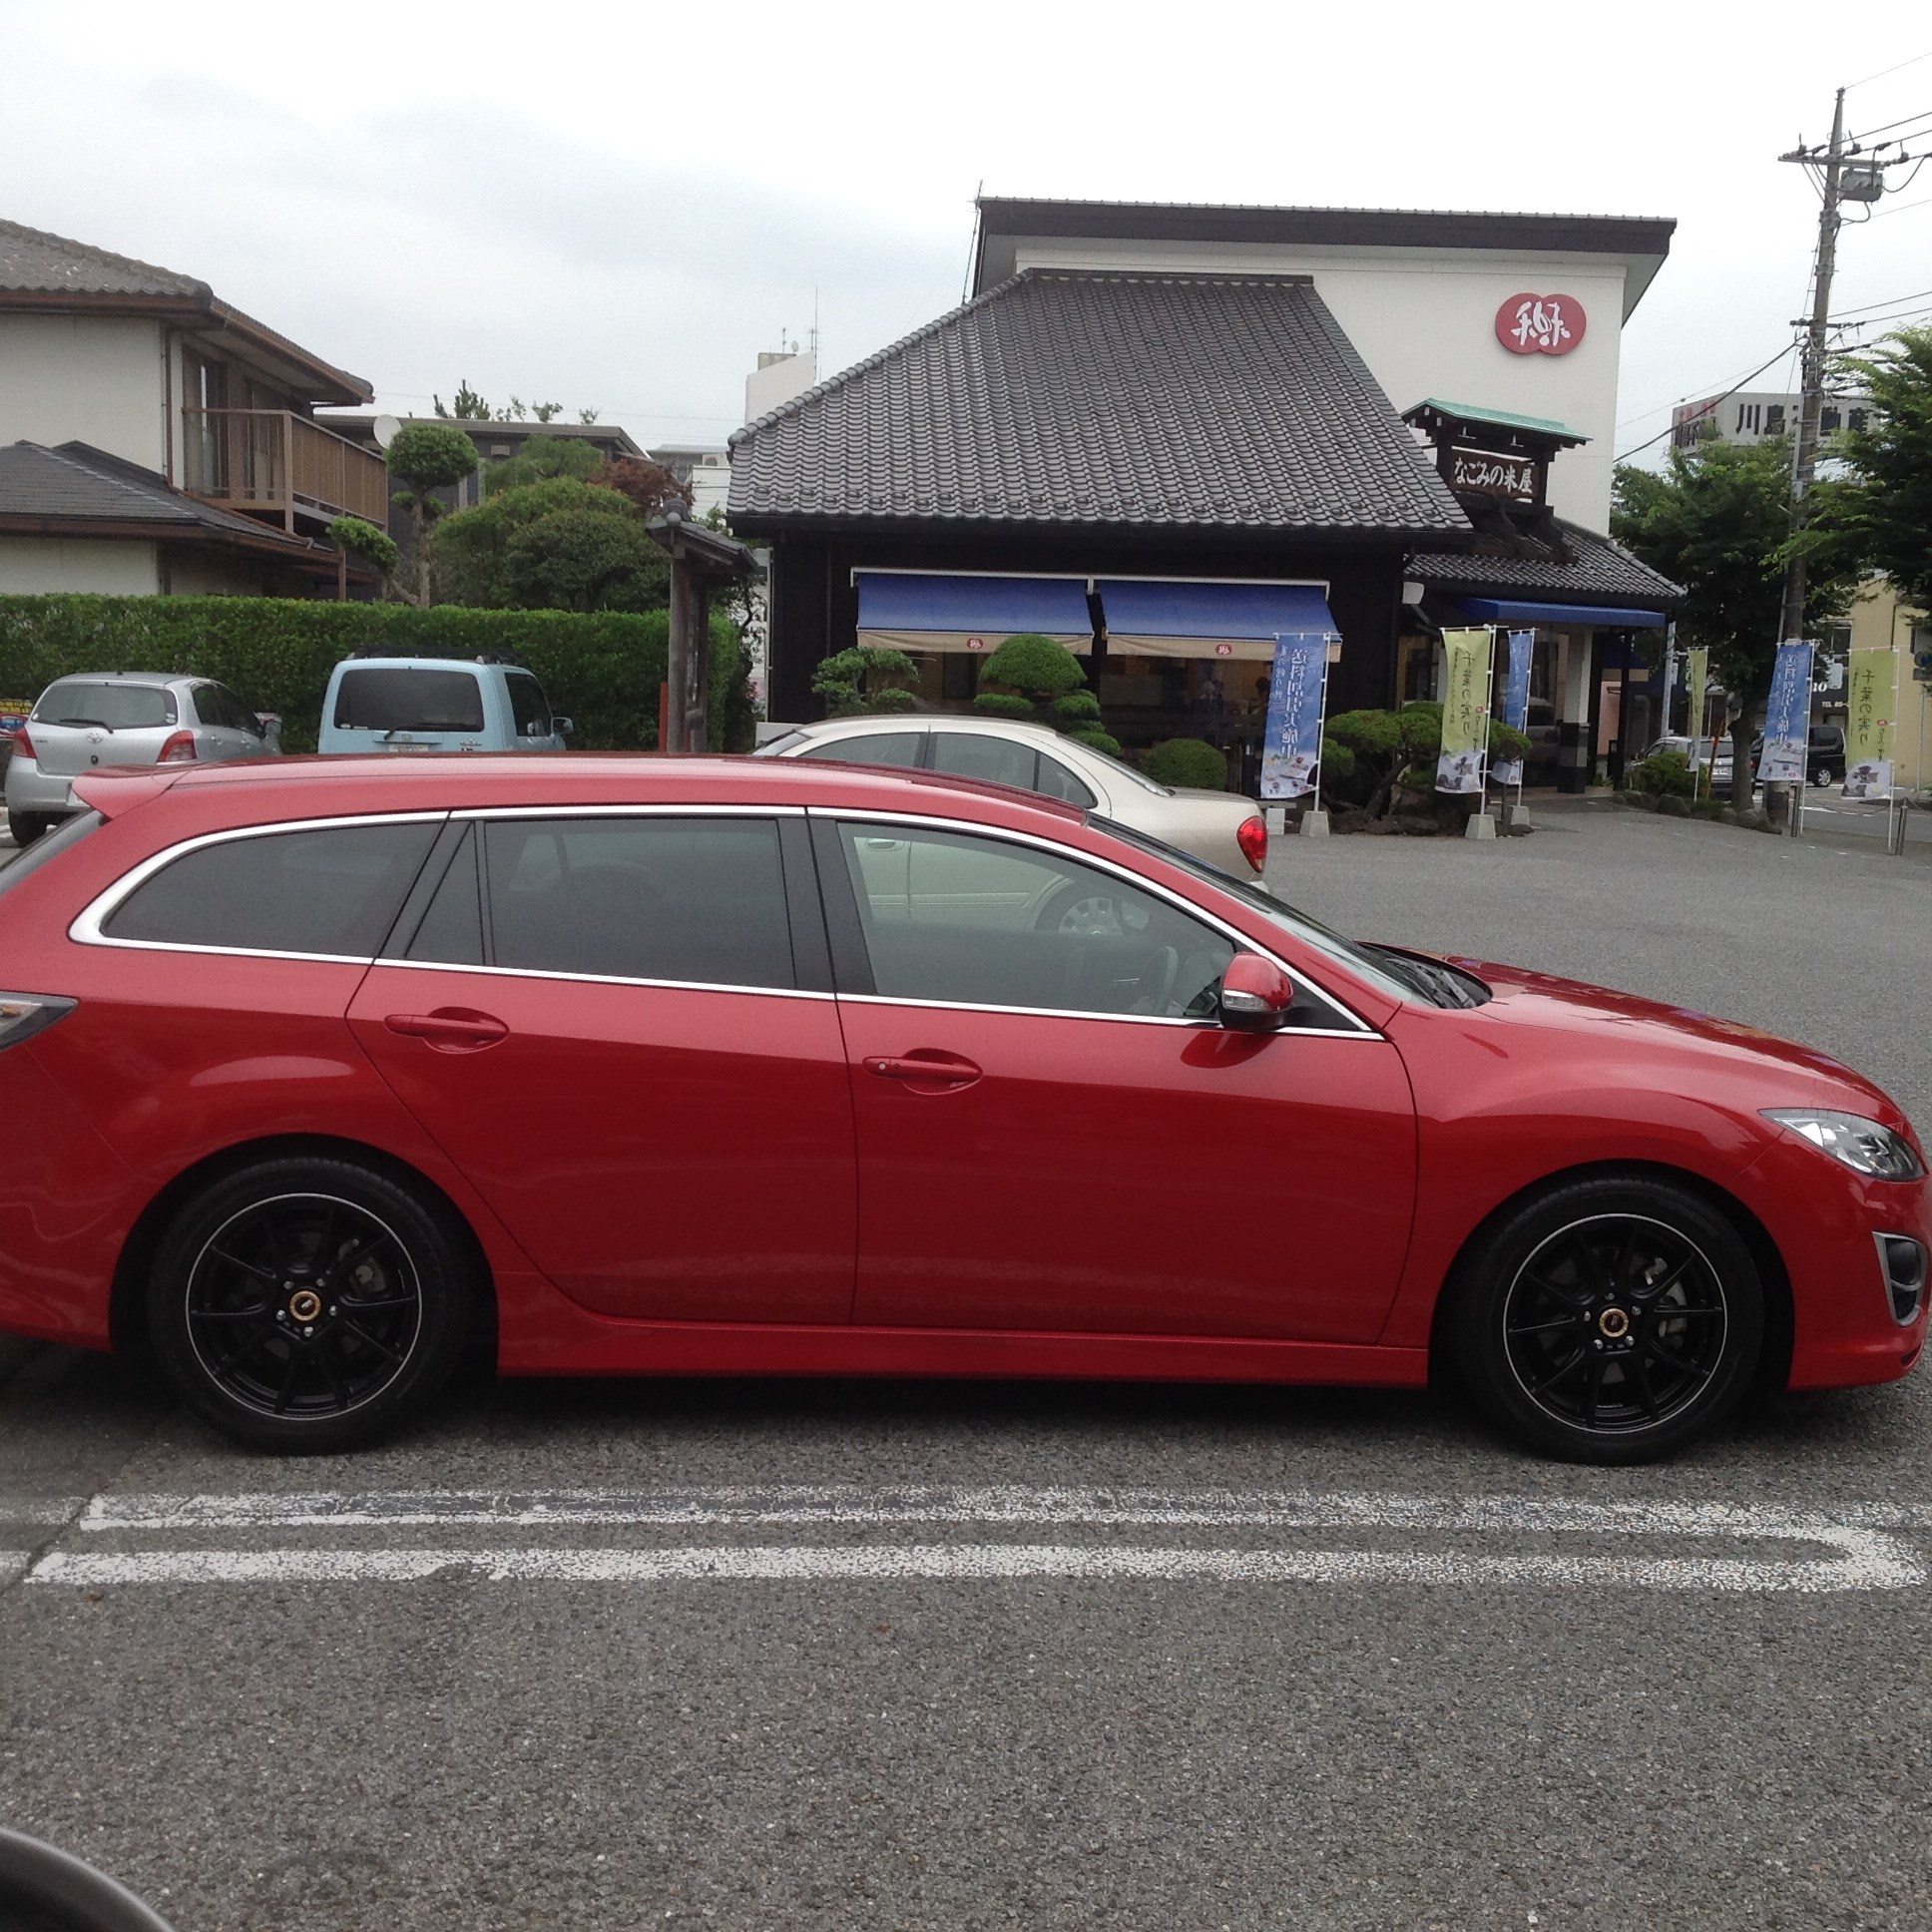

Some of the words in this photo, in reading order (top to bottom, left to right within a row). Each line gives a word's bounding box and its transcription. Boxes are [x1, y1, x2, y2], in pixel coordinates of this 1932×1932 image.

[1454, 456, 1533, 494] なごみの米屋
